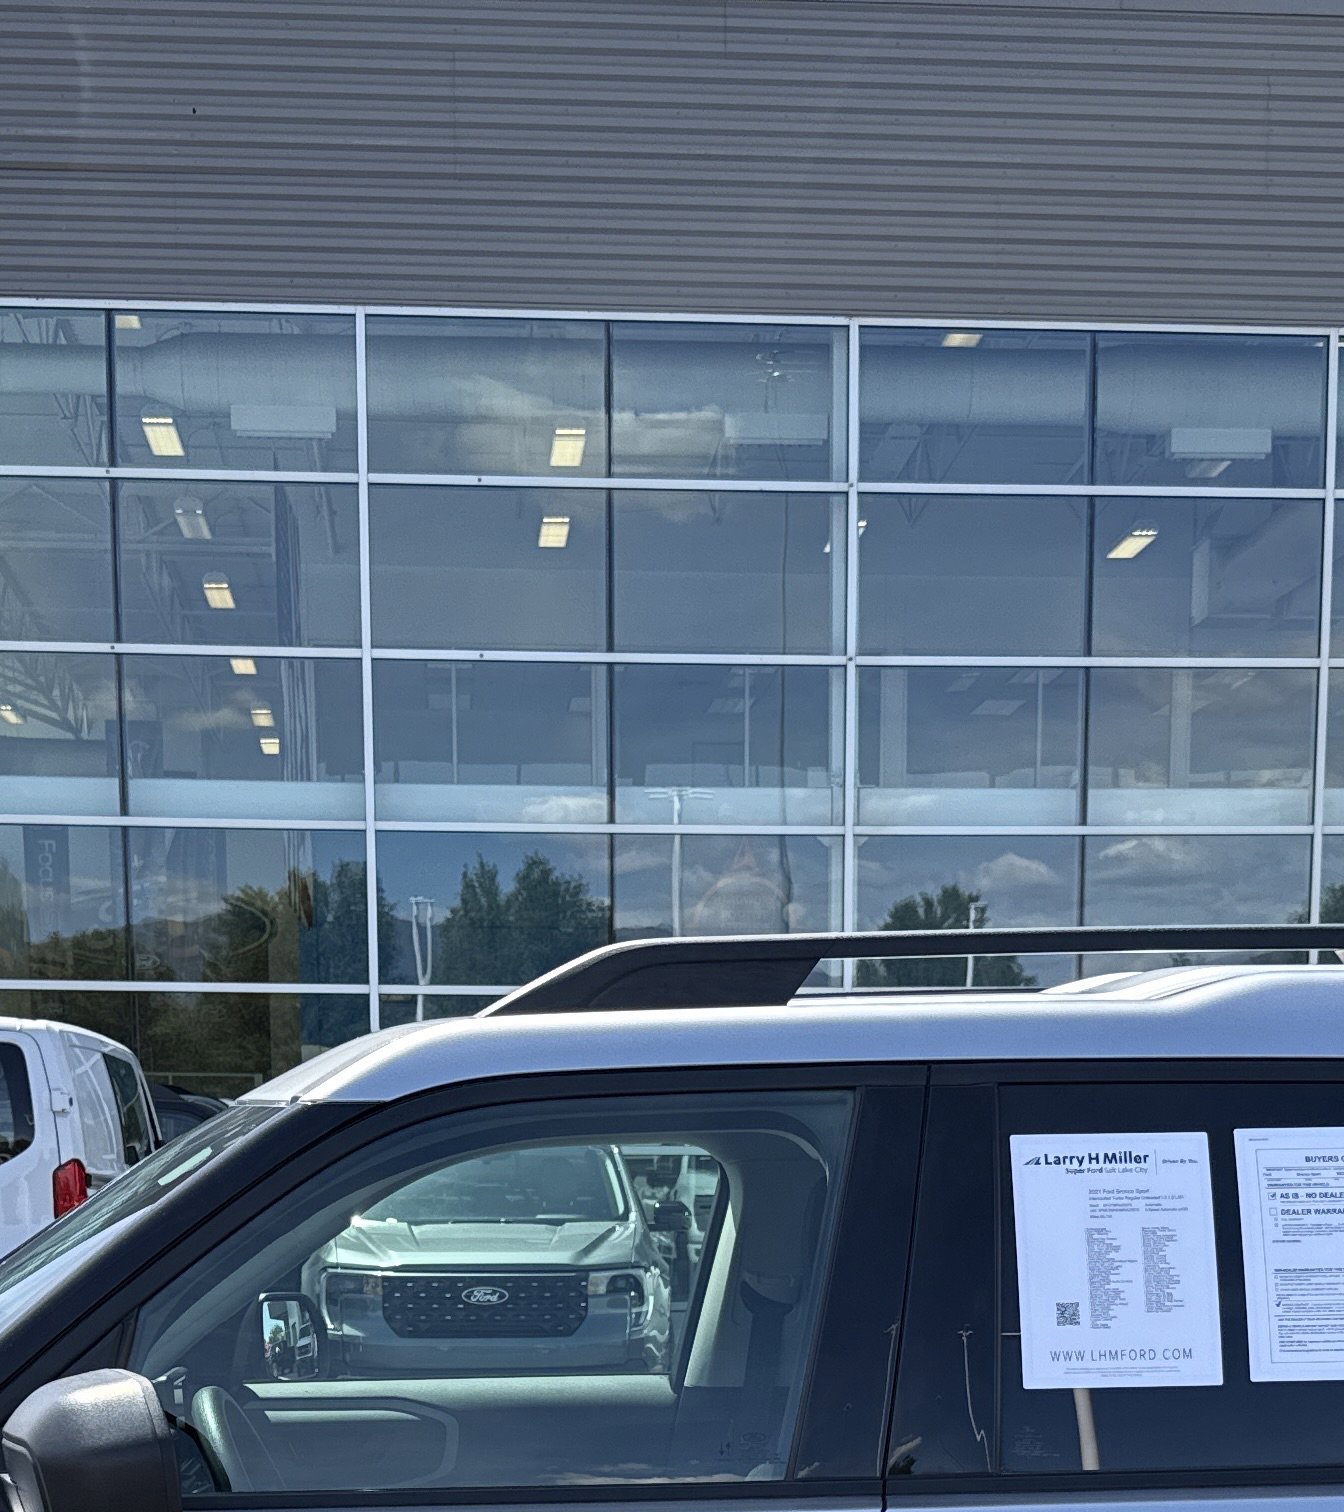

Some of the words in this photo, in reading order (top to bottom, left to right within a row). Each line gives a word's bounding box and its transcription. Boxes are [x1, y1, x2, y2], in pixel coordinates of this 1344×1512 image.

[1044, 1153, 1086, 1167] Larry
[1088, 1152, 1100, 1165] H
[1103, 1150, 1149, 1165] Miller
[1134, 1167, 1148, 1175] City
[1281, 1208, 1312, 1216] DEALER
[468, 1288, 501, 1302] Ford
[1049, 1347, 1193, 1362] WWWLHMFORDCOM
